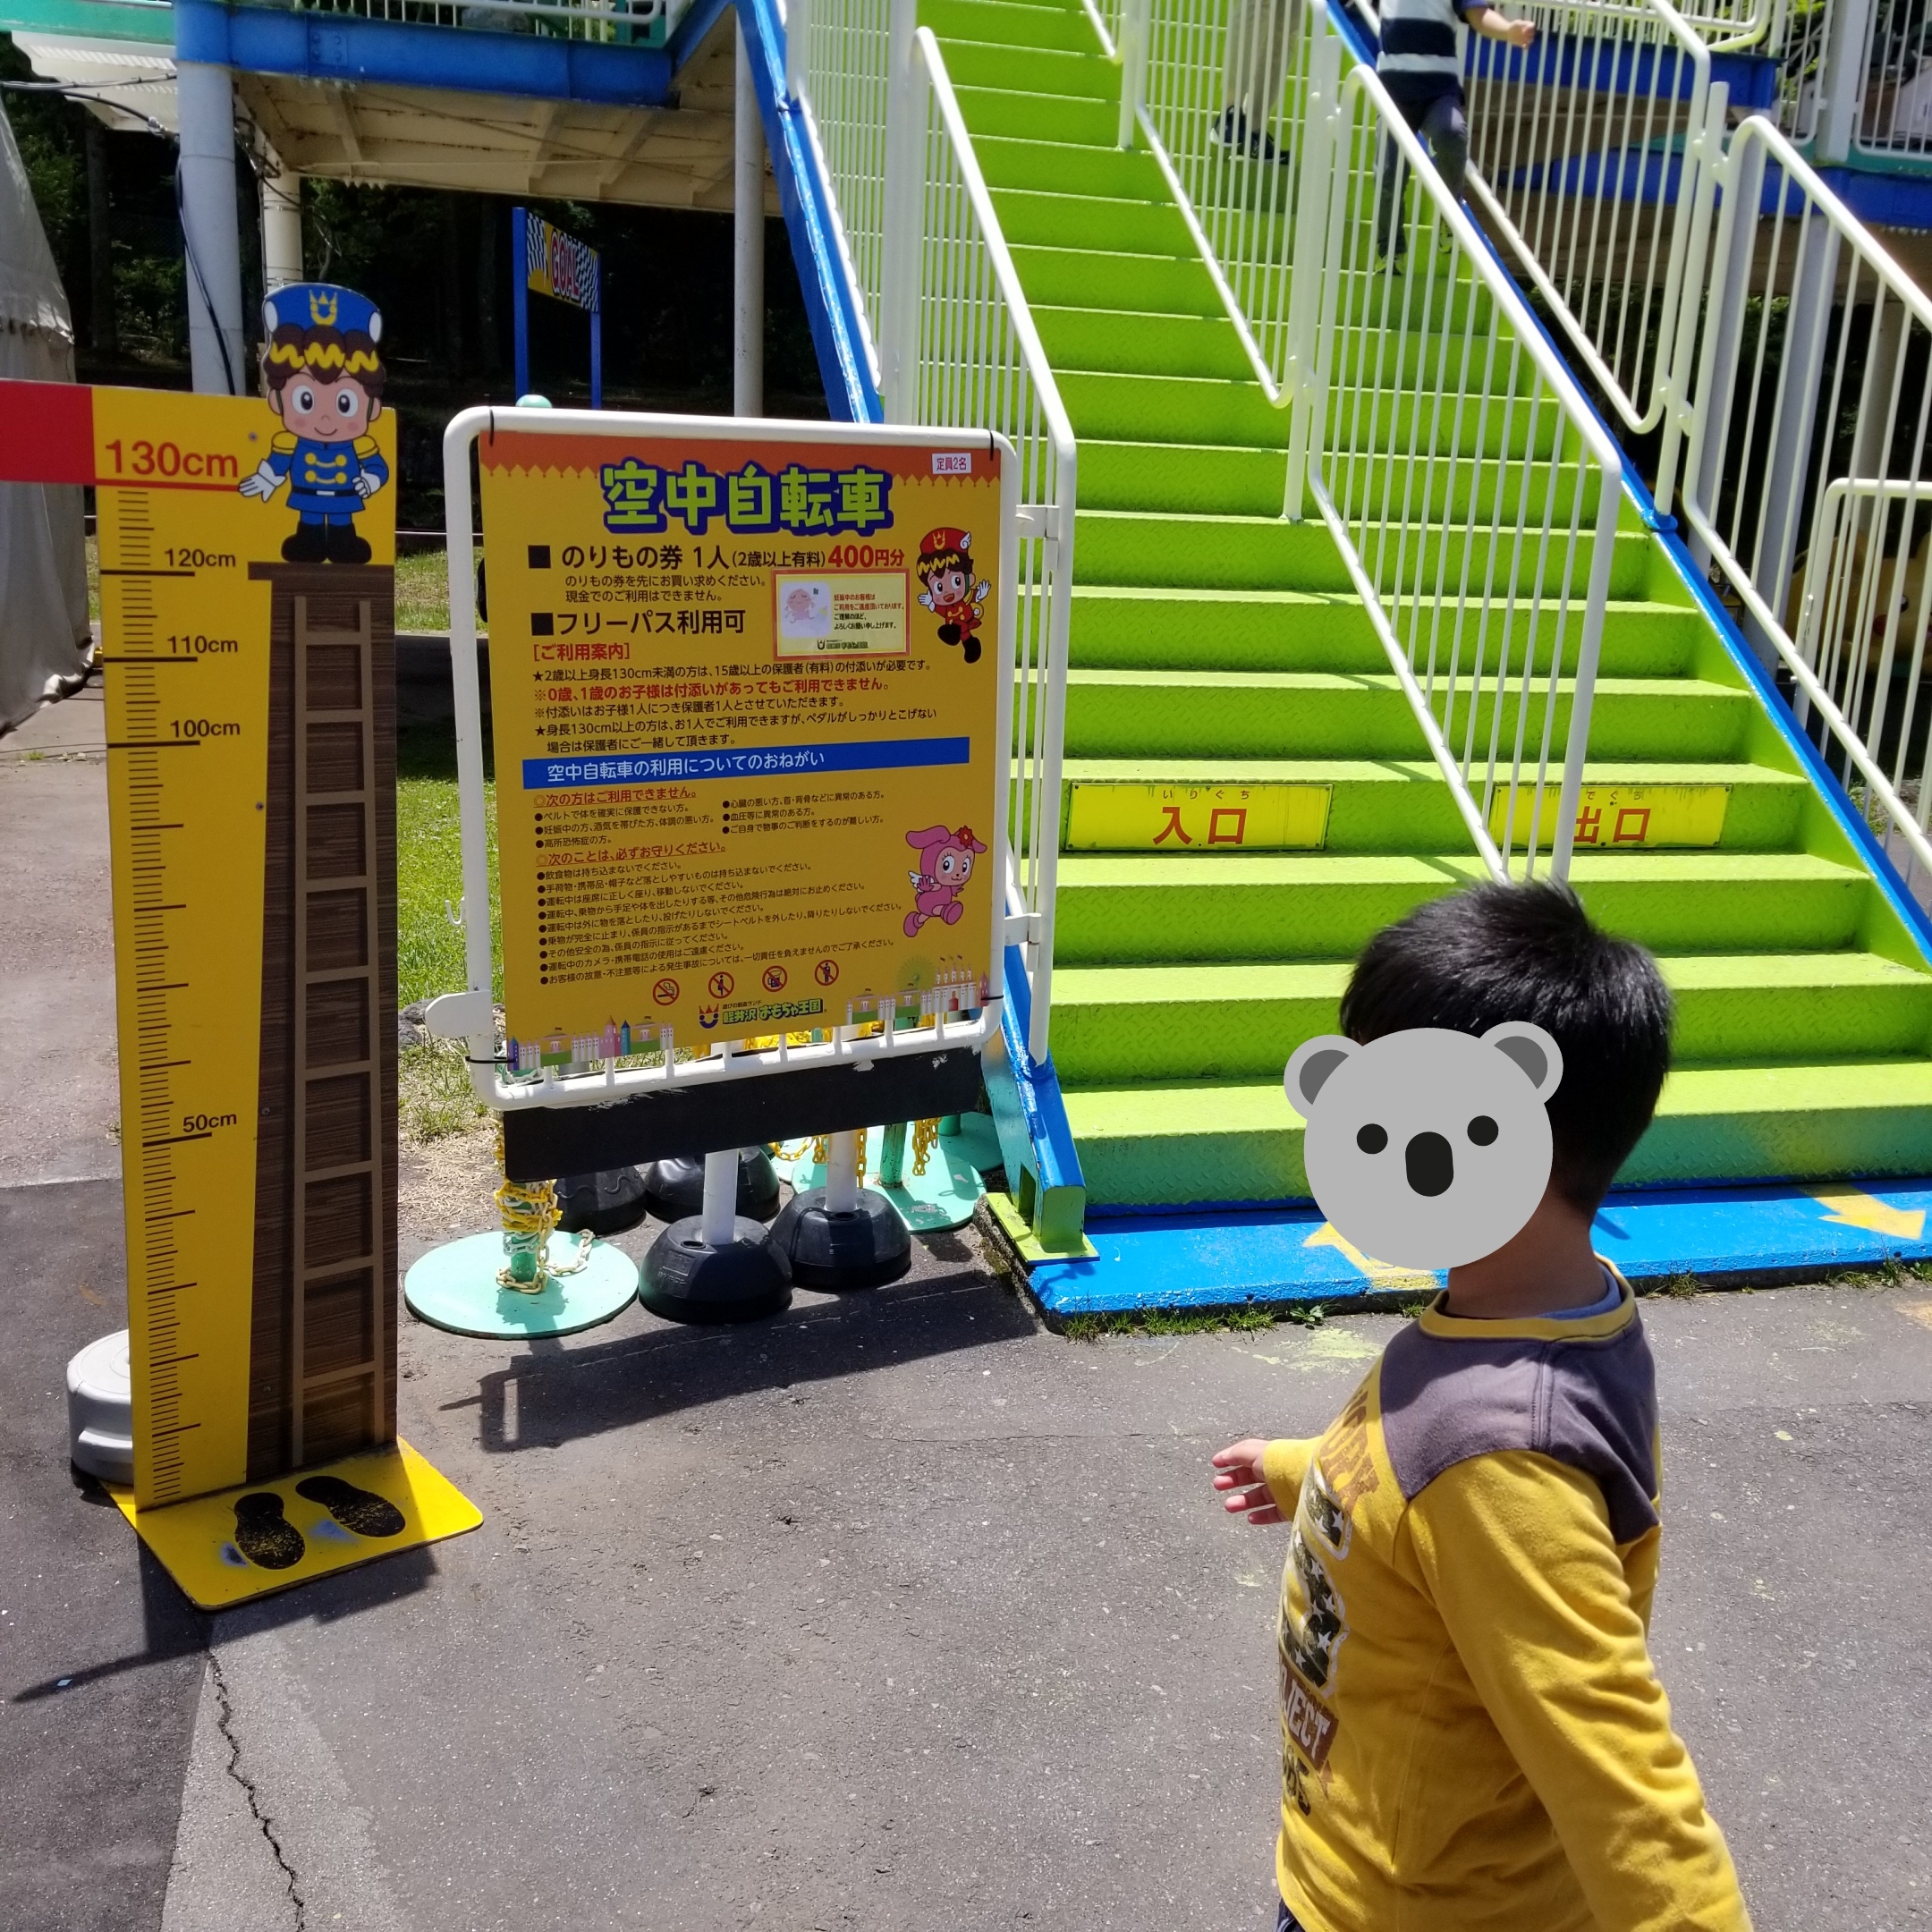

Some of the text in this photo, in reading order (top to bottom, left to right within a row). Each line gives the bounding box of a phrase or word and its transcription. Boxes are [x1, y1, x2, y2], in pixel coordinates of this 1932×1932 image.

[551, 229, 580, 301] GOAL
[106, 438, 239, 479] 130cm
[936, 457, 967, 471] 定員2名
[602, 459, 889, 532] 空中自転車
[164, 547, 237, 568] 120cm
[565, 574, 766, 588] のりもの券を先にお買い求めください。
[565, 589, 723, 603] 現金でのご利用はできません。
[167, 635, 239, 655] 110cm
[170, 718, 241, 739] 100cm
[547, 750, 825, 782] 空中自転車の利用についてのおねがい
[1152, 806, 1248, 845] 入口
[1573, 805, 1651, 844] 出口
[722, 1008, 758, 1024] 軽井沢
[182, 1110, 238, 1134] 50cm
